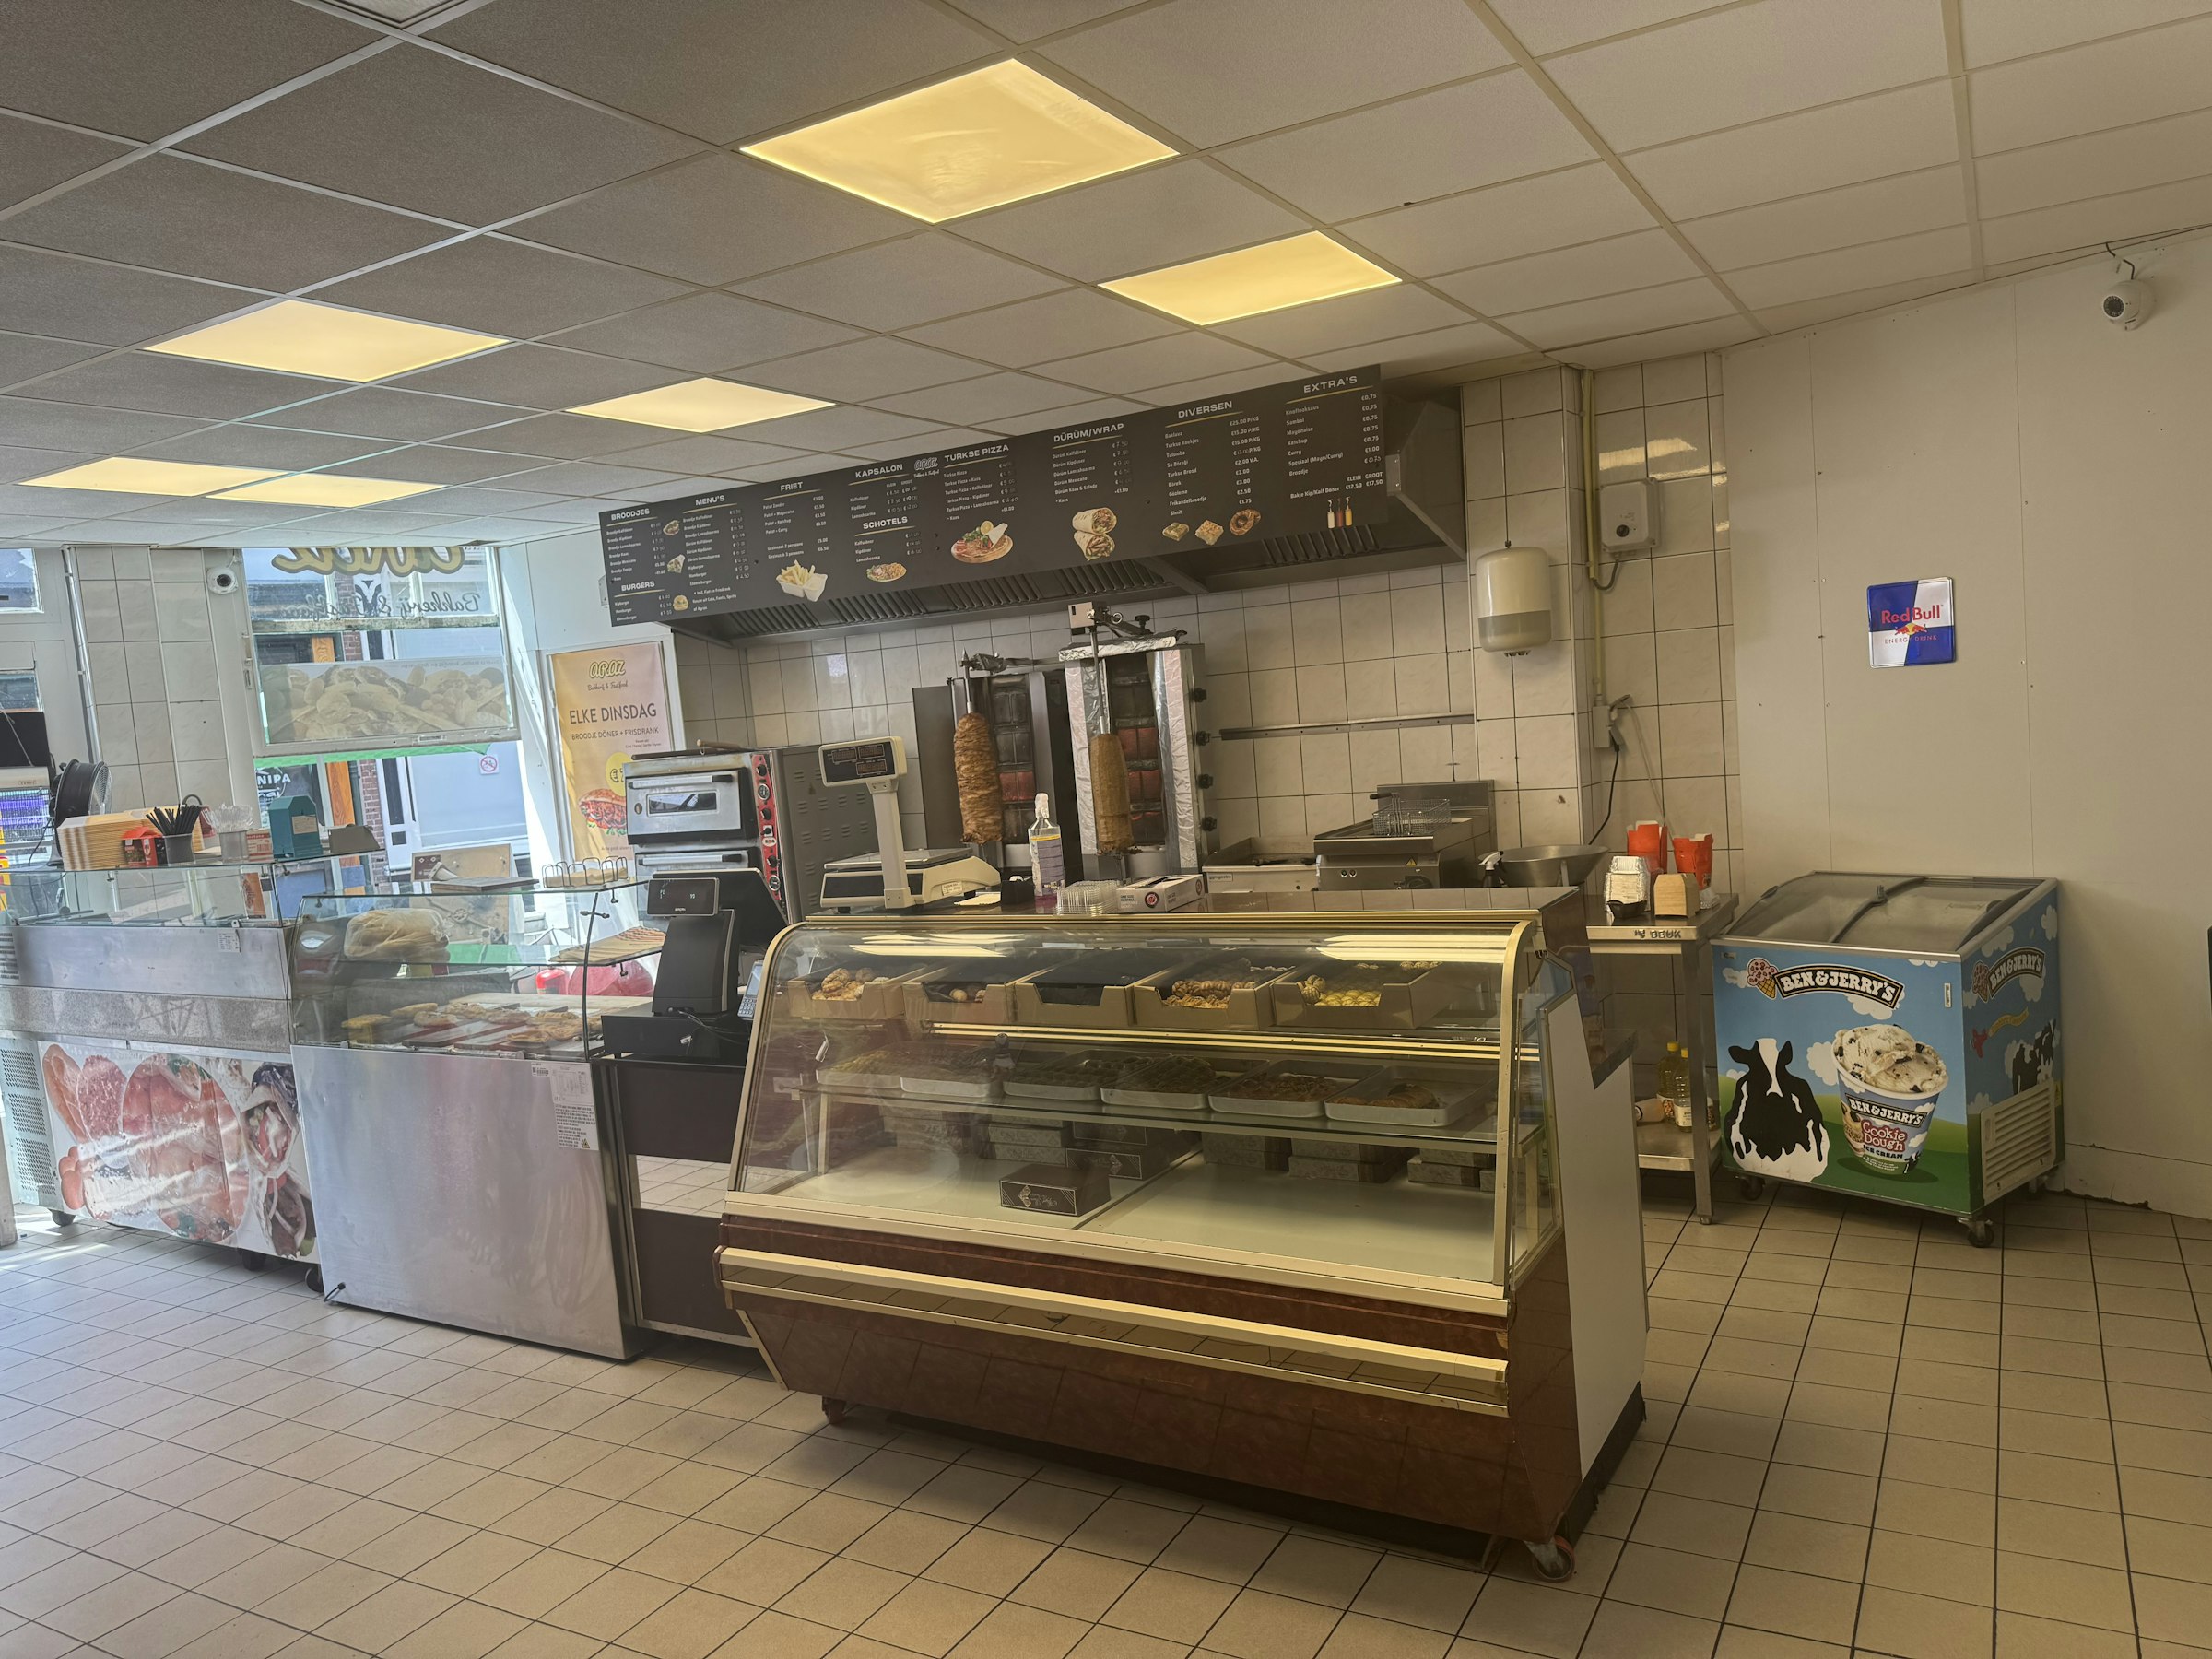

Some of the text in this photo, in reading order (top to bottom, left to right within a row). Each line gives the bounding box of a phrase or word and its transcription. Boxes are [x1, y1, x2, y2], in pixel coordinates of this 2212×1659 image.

[1304, 376, 1357, 393] EXTRA'S
[1179, 401, 1232, 418] DIVERSEN
[1054, 423, 1124, 442] DÜRÜM/WRAP
[945, 445, 1009, 462] TURKSE PIZZA
[855, 464, 902, 477] KAPSALON
[781, 482, 803, 491] FRIET
[696, 495, 724, 505] MENU'S
[611, 509, 650, 520] BROODJES
[863, 516, 908, 529] SCHOTELS
[621, 582, 654, 591] BURGERS
[1881, 605, 1940, 624] Red Bull
[570, 703, 656, 724] ELKE DINSDAG
[598, 730, 618, 738] DÖNER
[625, 727, 659, 735] FRISDRANK
[1652, 930, 1681, 938] BEUK
[1863, 1122, 1905, 1141] Cookie
[1865, 1133, 1903, 1151] Dough
[1864, 1145, 1875, 1153] ICE
